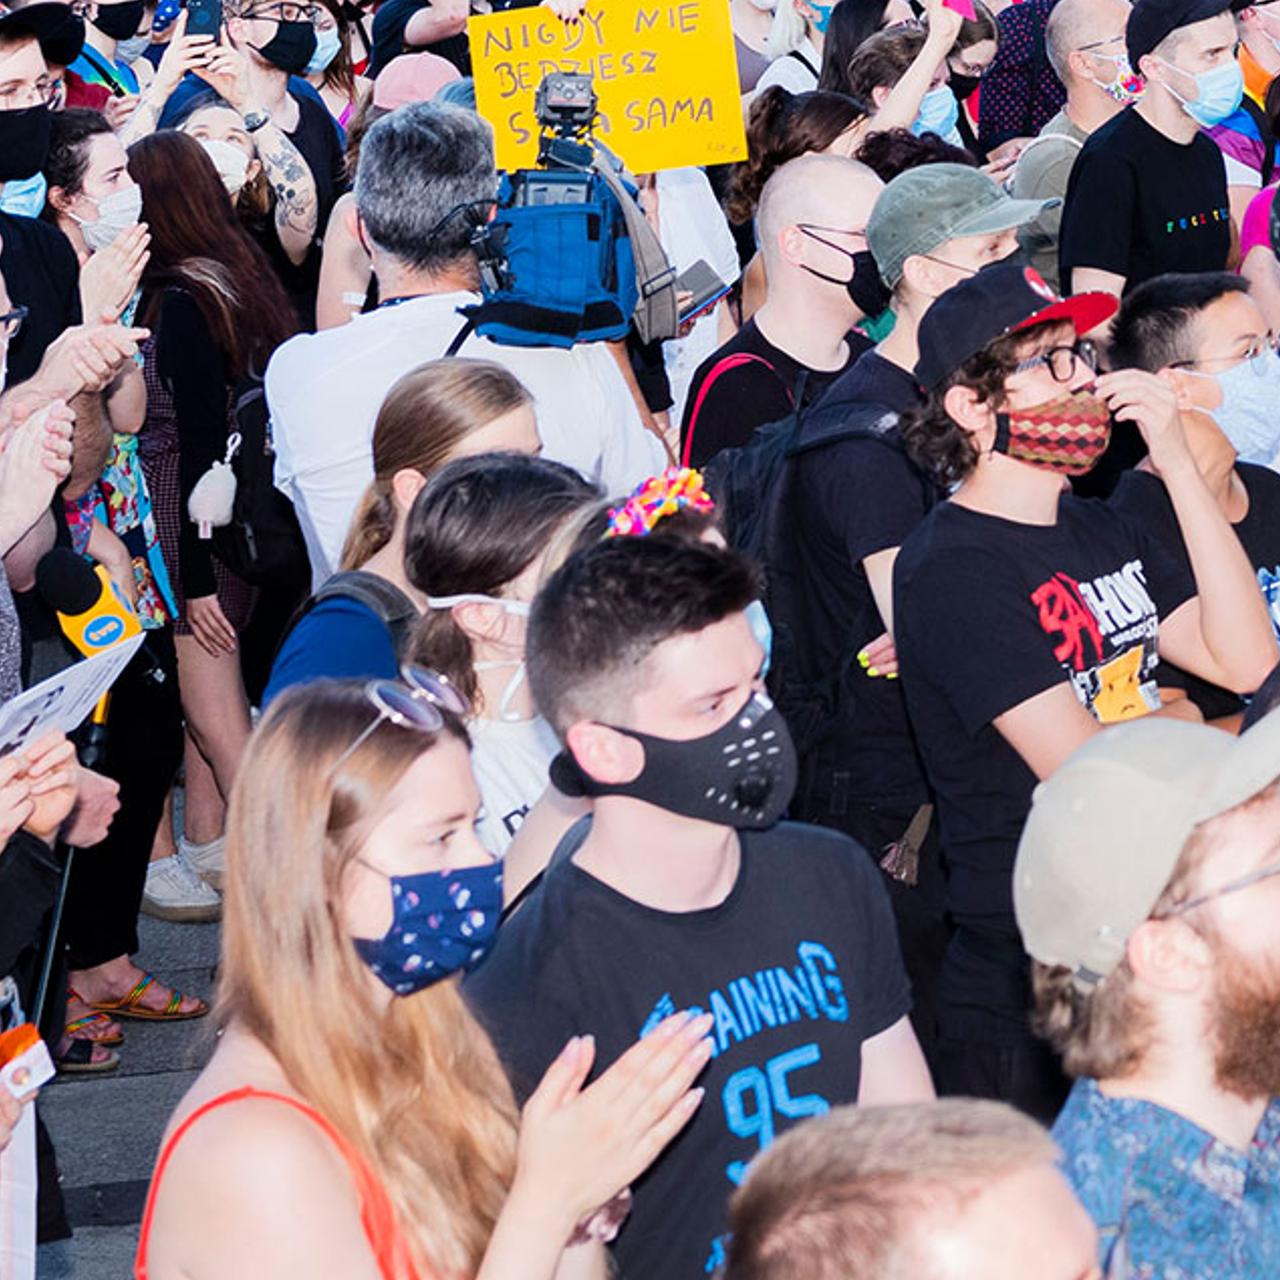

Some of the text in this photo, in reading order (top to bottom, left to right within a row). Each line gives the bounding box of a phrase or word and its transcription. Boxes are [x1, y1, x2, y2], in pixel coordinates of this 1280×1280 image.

[484, 2, 700, 58] NIGDY NIE
[625, 96, 714, 133] SAMA
[639, 940, 850, 1058] AINING
[721, 1042, 831, 1150] 95
